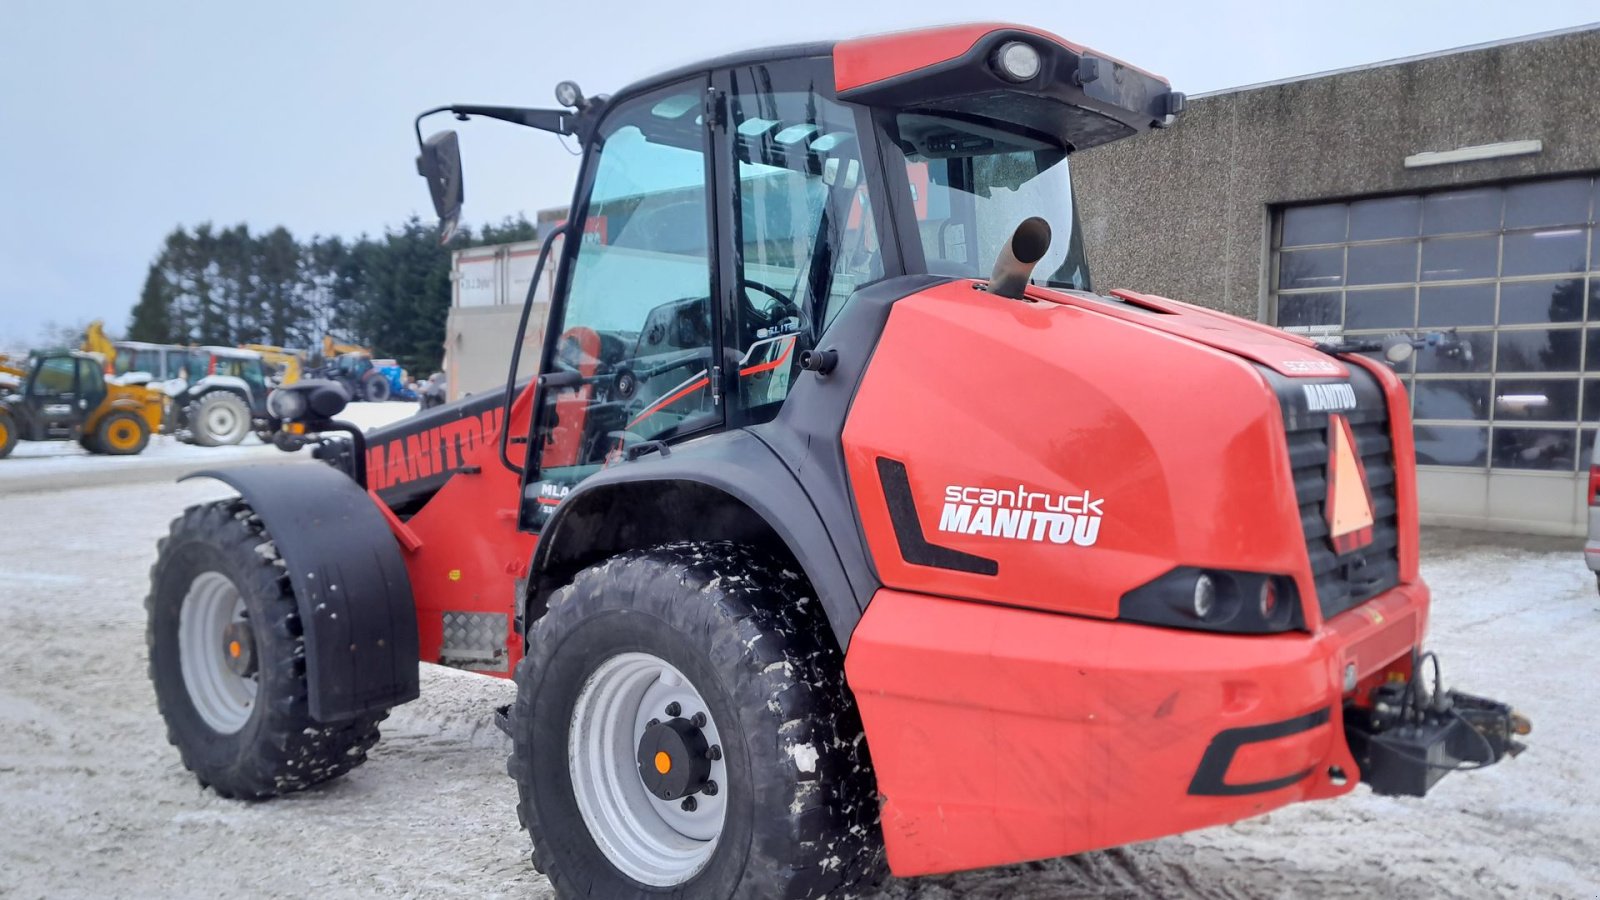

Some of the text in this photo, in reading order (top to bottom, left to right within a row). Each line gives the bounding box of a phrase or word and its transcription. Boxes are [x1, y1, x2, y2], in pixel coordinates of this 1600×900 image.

[1303, 384, 1356, 411] MANITOU
[944, 484, 1105, 516] scantruck
[938, 503, 1101, 546] MANITOU
